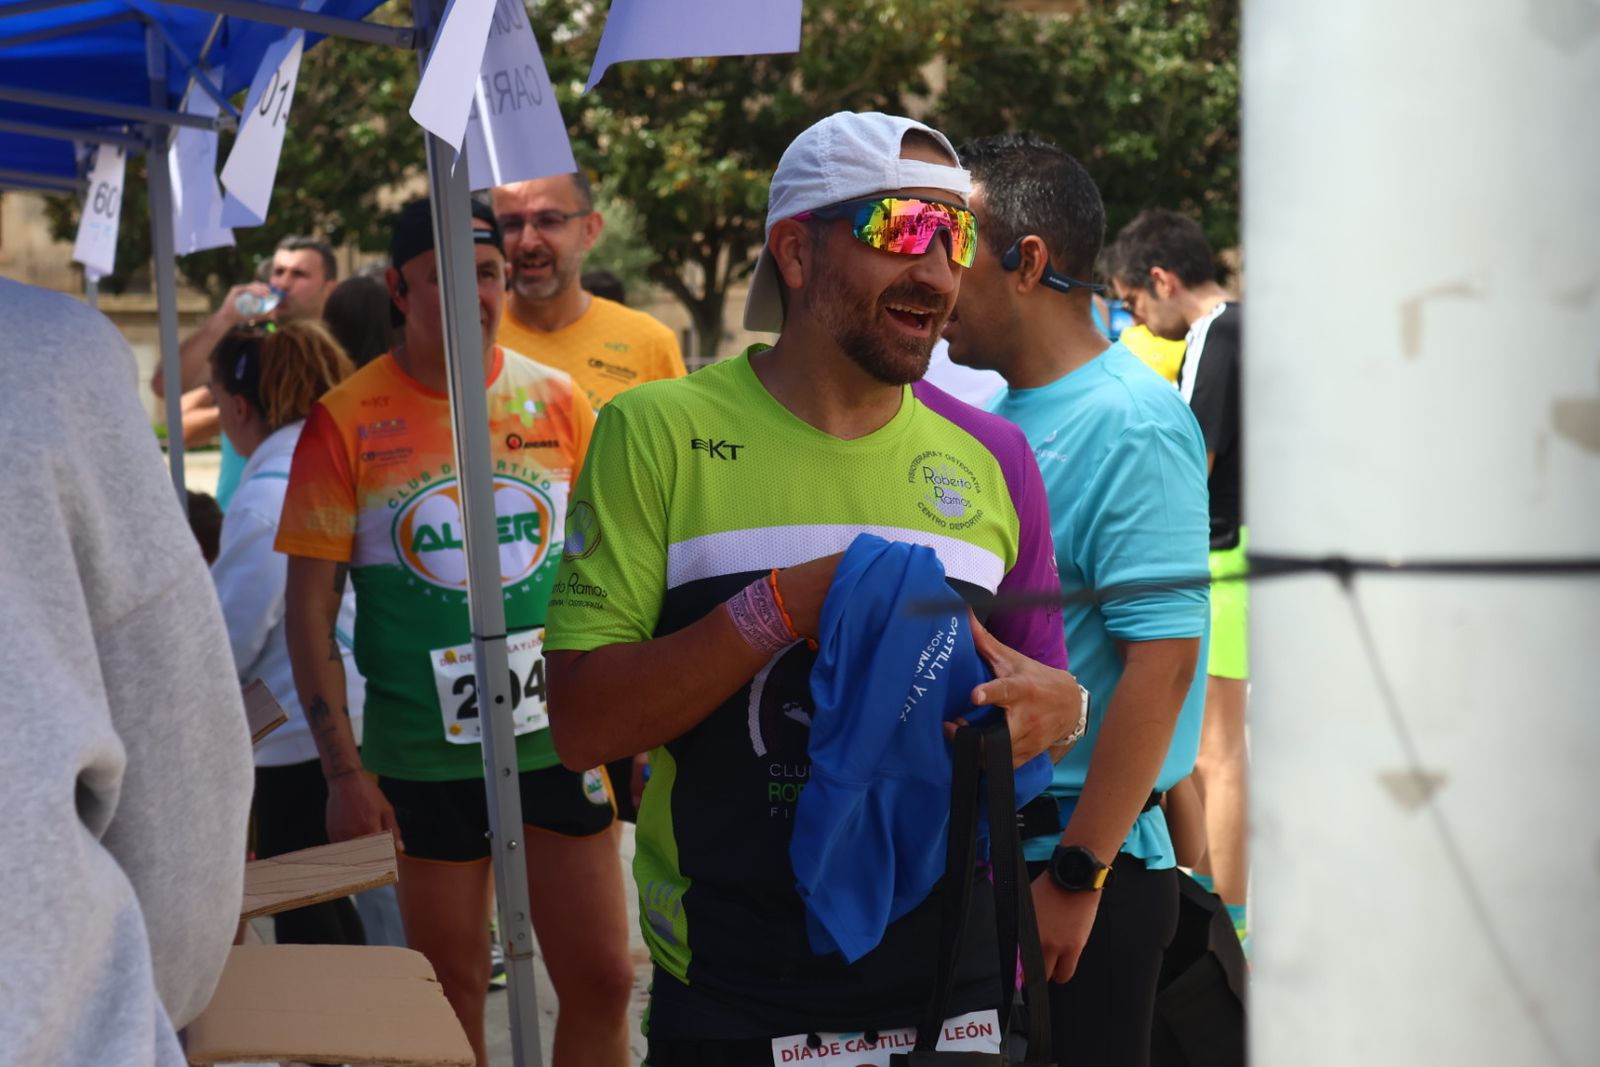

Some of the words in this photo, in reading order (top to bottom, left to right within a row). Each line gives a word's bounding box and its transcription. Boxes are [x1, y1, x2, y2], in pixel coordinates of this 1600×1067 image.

[441, 459, 551, 490] DRTIVO
[922, 465, 972, 490] Roberto
[934, 485, 972, 508] Ramos
[411, 511, 543, 554] ALER
[769, 763, 812, 778] CLU
[817, 1041, 842, 1058] DE
[845, 1033, 916, 1052] CASTILL
[944, 1021, 993, 1041] LEÓN
